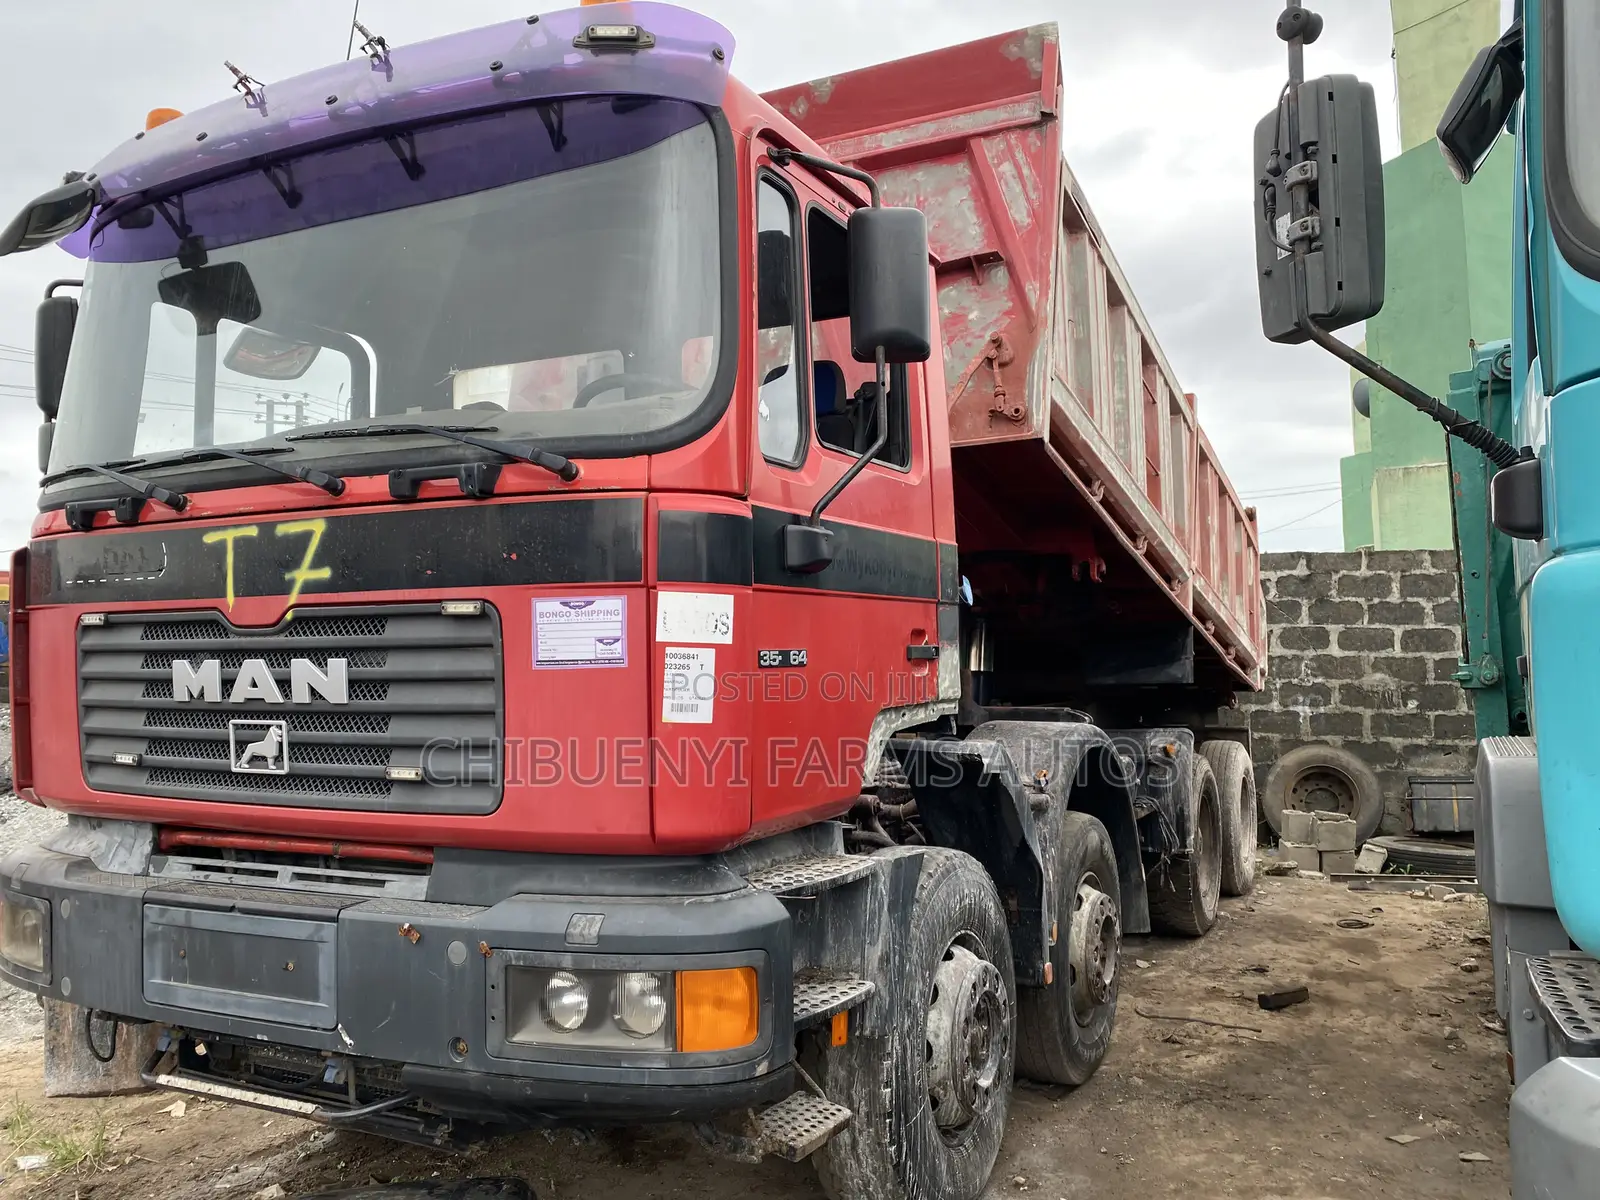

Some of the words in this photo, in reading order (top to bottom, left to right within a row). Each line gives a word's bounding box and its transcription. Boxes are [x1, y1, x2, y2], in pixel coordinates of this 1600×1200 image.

[538, 610, 572, 619] BONGO
[574, 609, 620, 617] SHIPPING
[790, 650, 807, 665] 64
[173, 658, 349, 704] MAN
